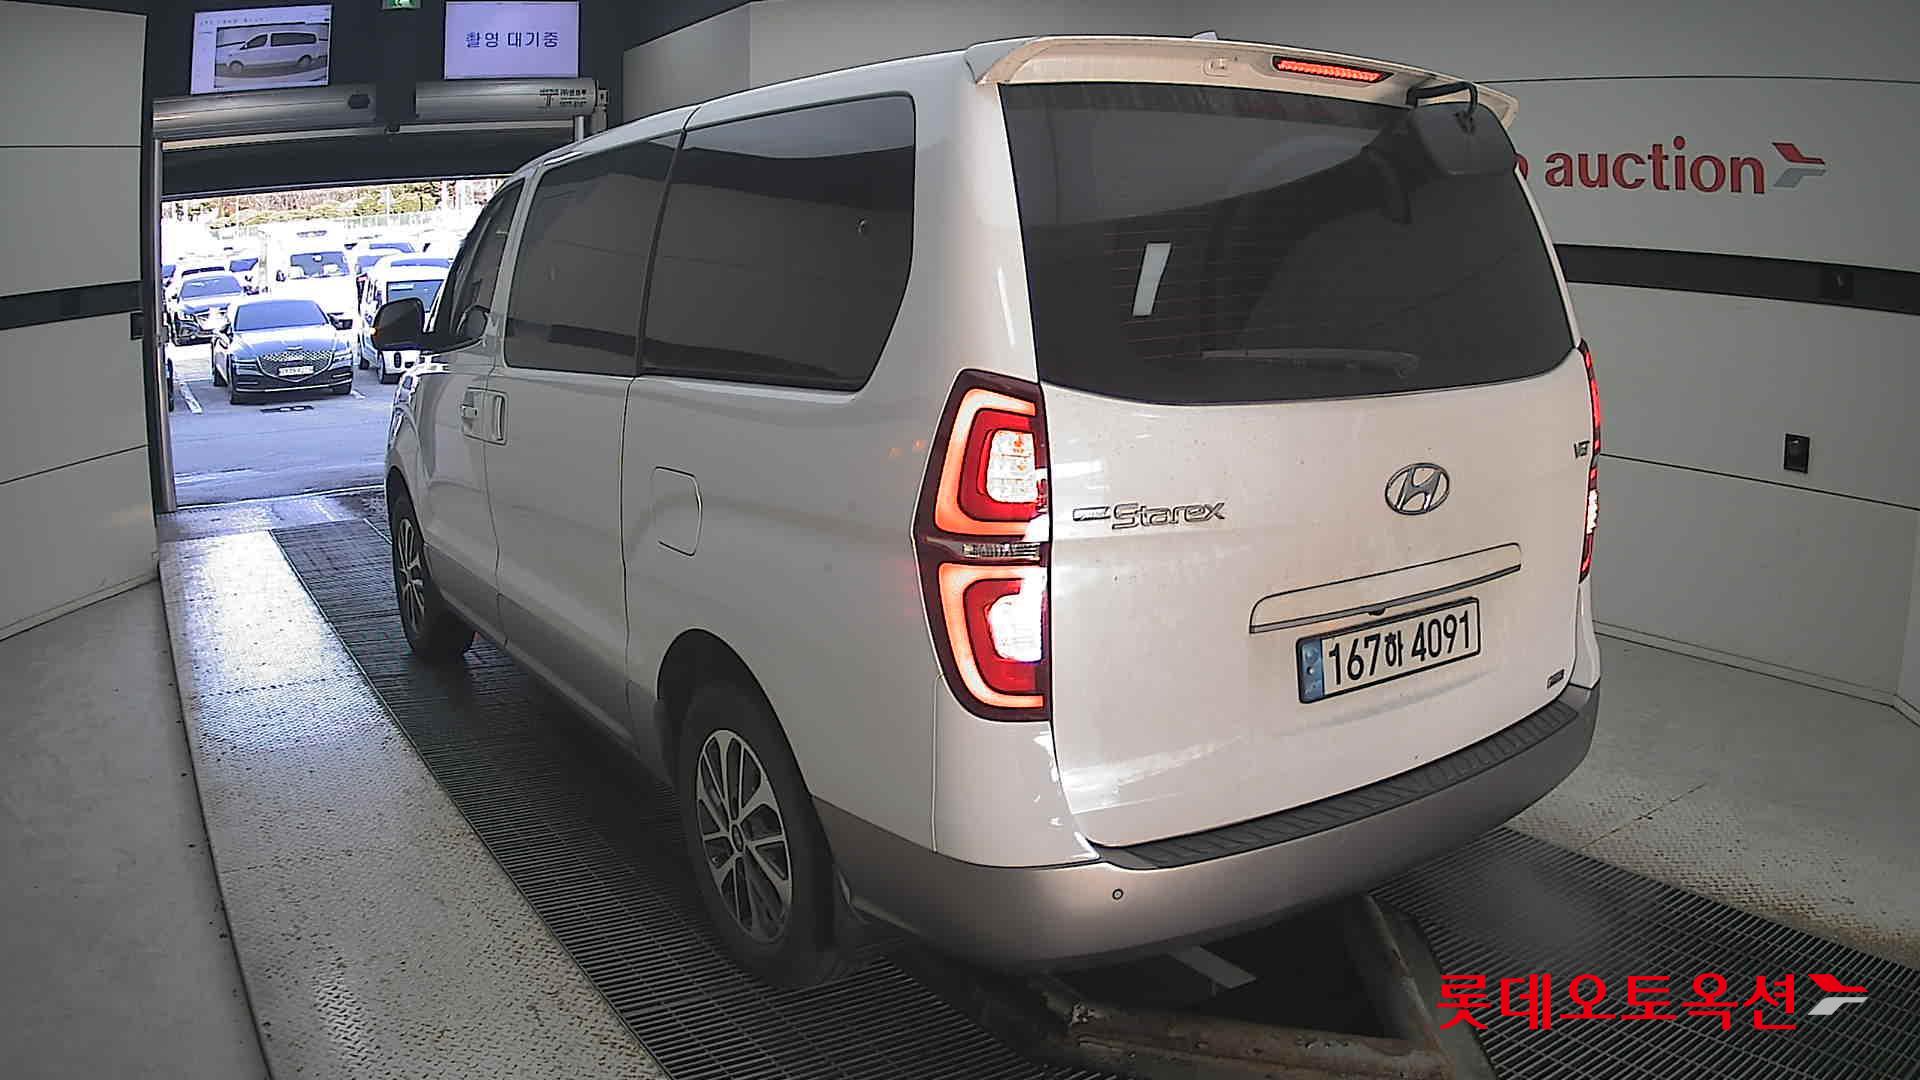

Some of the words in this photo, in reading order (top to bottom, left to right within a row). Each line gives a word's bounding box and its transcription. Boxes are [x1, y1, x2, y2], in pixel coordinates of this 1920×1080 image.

[507, 31, 560, 48] 대기중
[1545, 135, 1766, 195] auction
[1112, 502, 1226, 530] Starex
[1328, 629, 1404, 686] 167하
[1411, 609, 1471, 662] 4091
